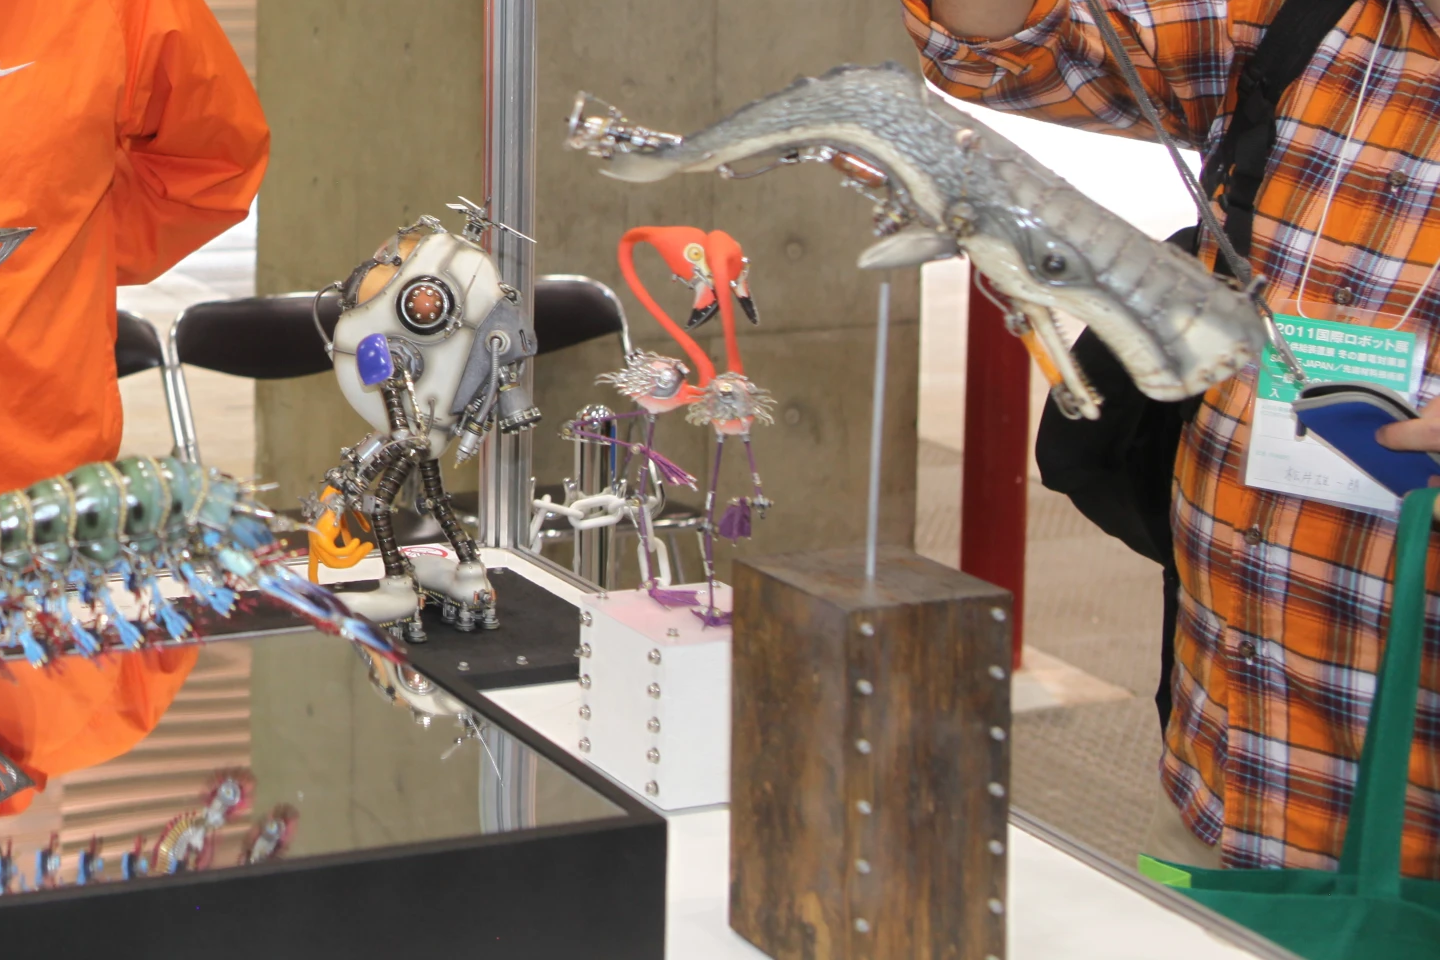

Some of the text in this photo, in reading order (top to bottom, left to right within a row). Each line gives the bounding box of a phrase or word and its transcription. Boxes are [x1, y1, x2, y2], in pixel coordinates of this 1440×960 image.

[1275, 322, 1409, 354] 2011国際ロボット展
